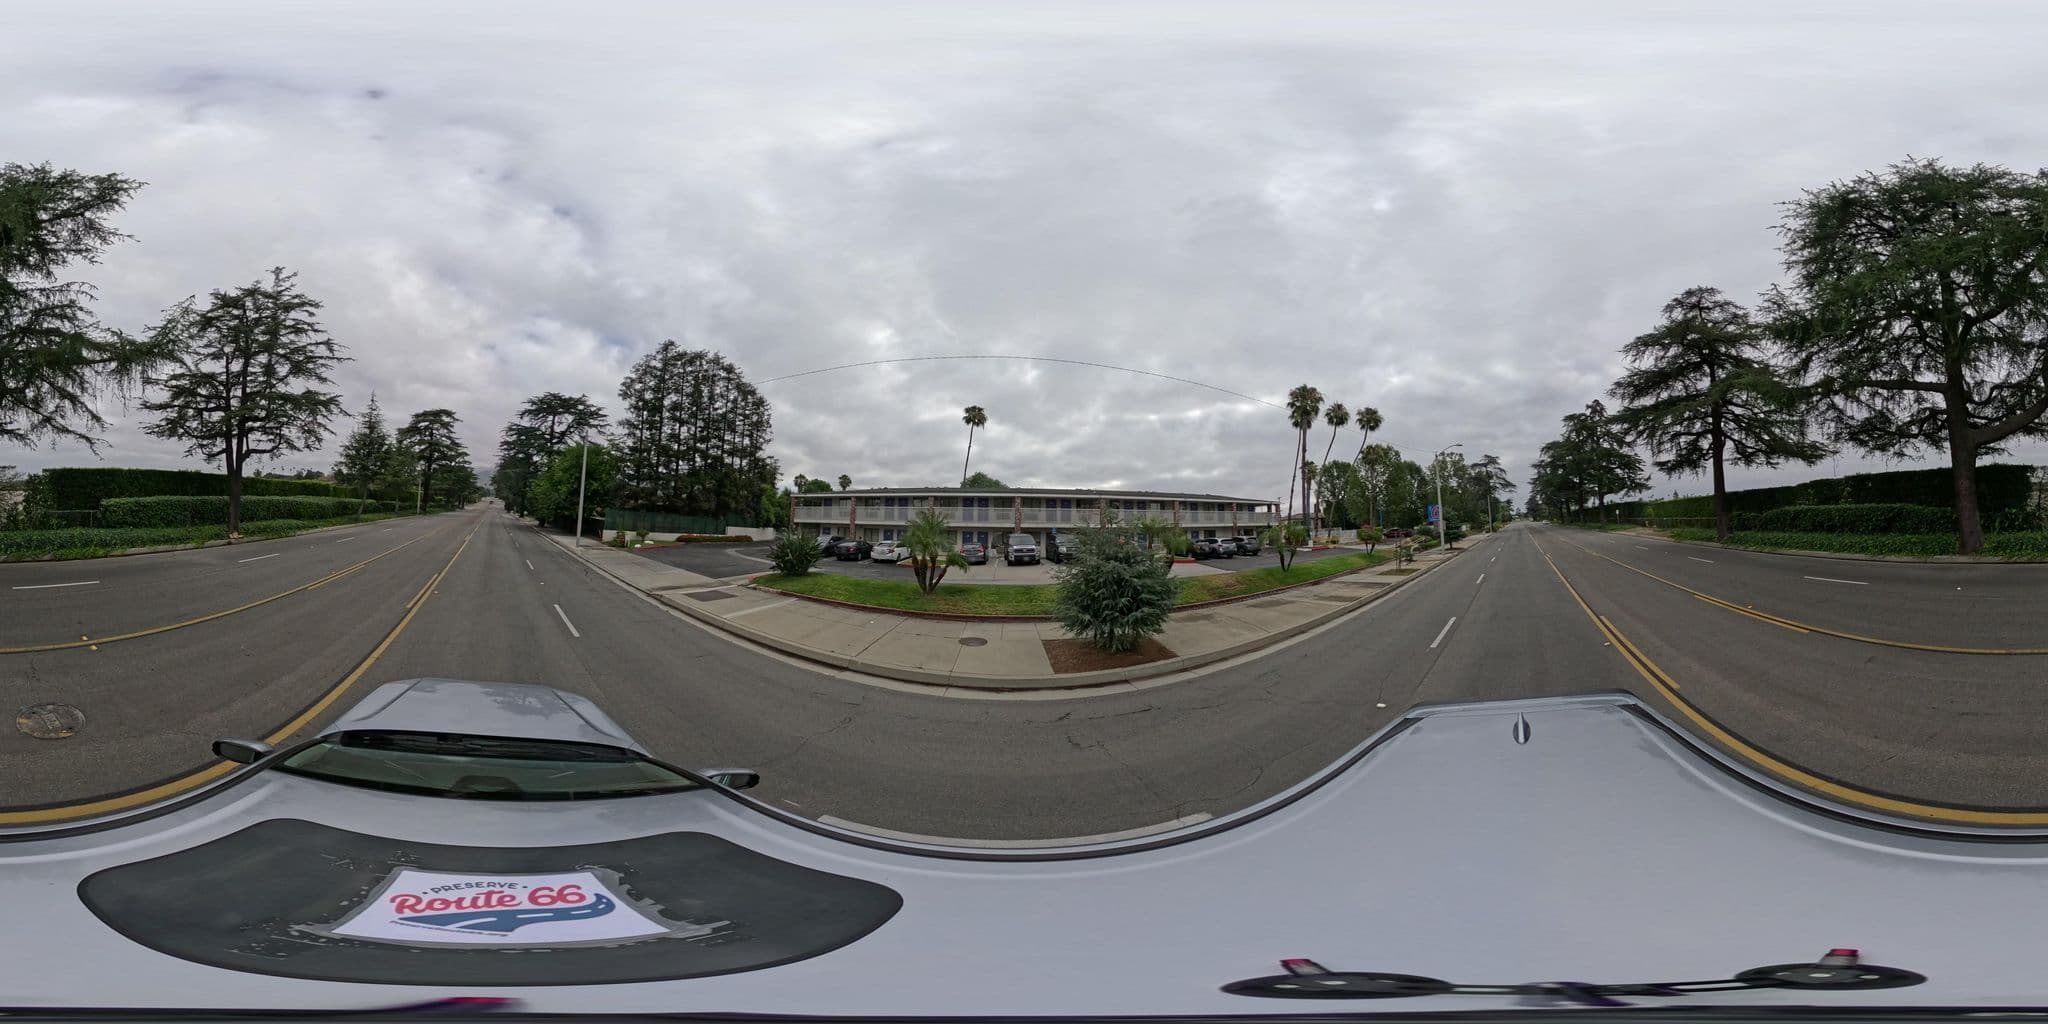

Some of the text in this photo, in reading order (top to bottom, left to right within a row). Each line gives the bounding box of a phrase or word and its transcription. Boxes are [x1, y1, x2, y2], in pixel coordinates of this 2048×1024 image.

[430, 881, 520, 894] PRESERVE
[389, 884, 587, 914] Route 66
